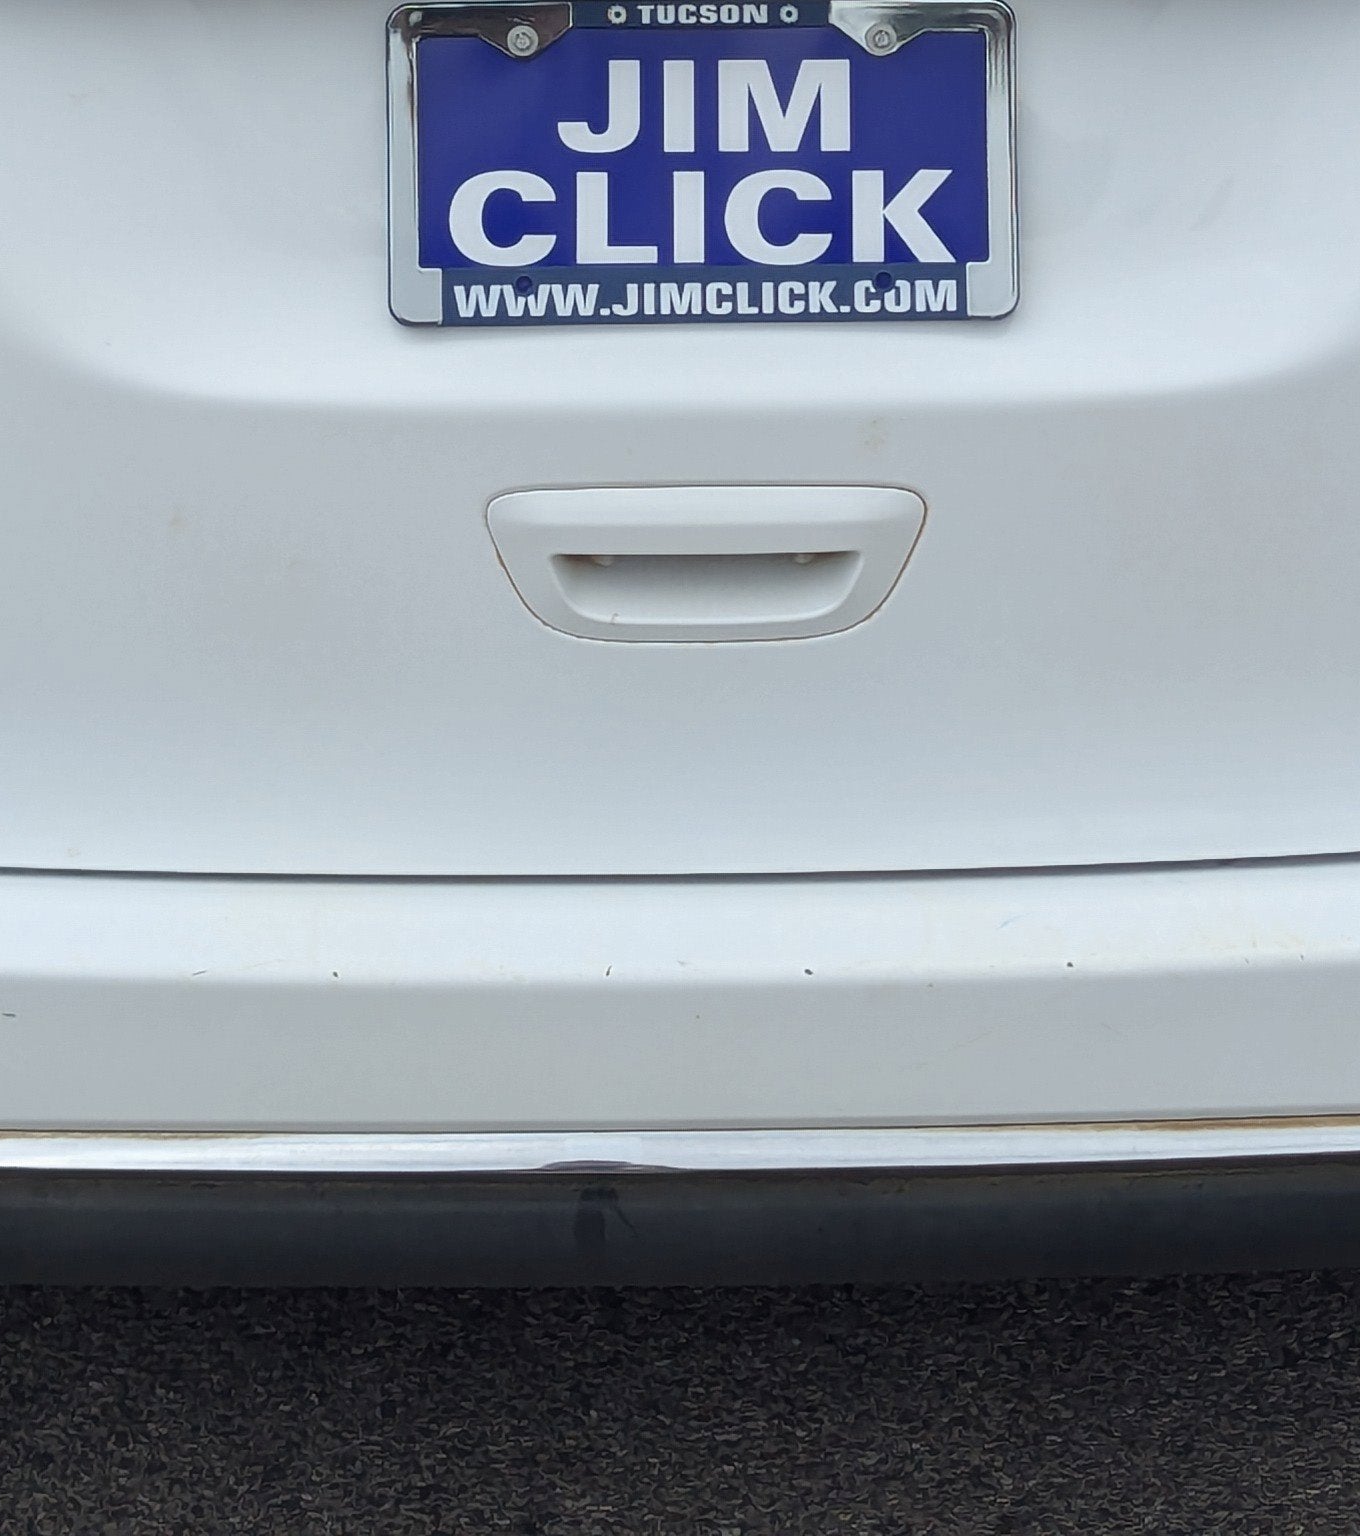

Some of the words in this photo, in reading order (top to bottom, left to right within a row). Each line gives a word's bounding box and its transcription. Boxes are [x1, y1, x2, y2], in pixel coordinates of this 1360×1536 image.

[636, 4, 770, 25] TUCSON
[557, 58, 851, 154] JIM
[447, 168, 957, 267] CLICK
[453, 278, 959, 318] WWW.JIMCLICK.COM
